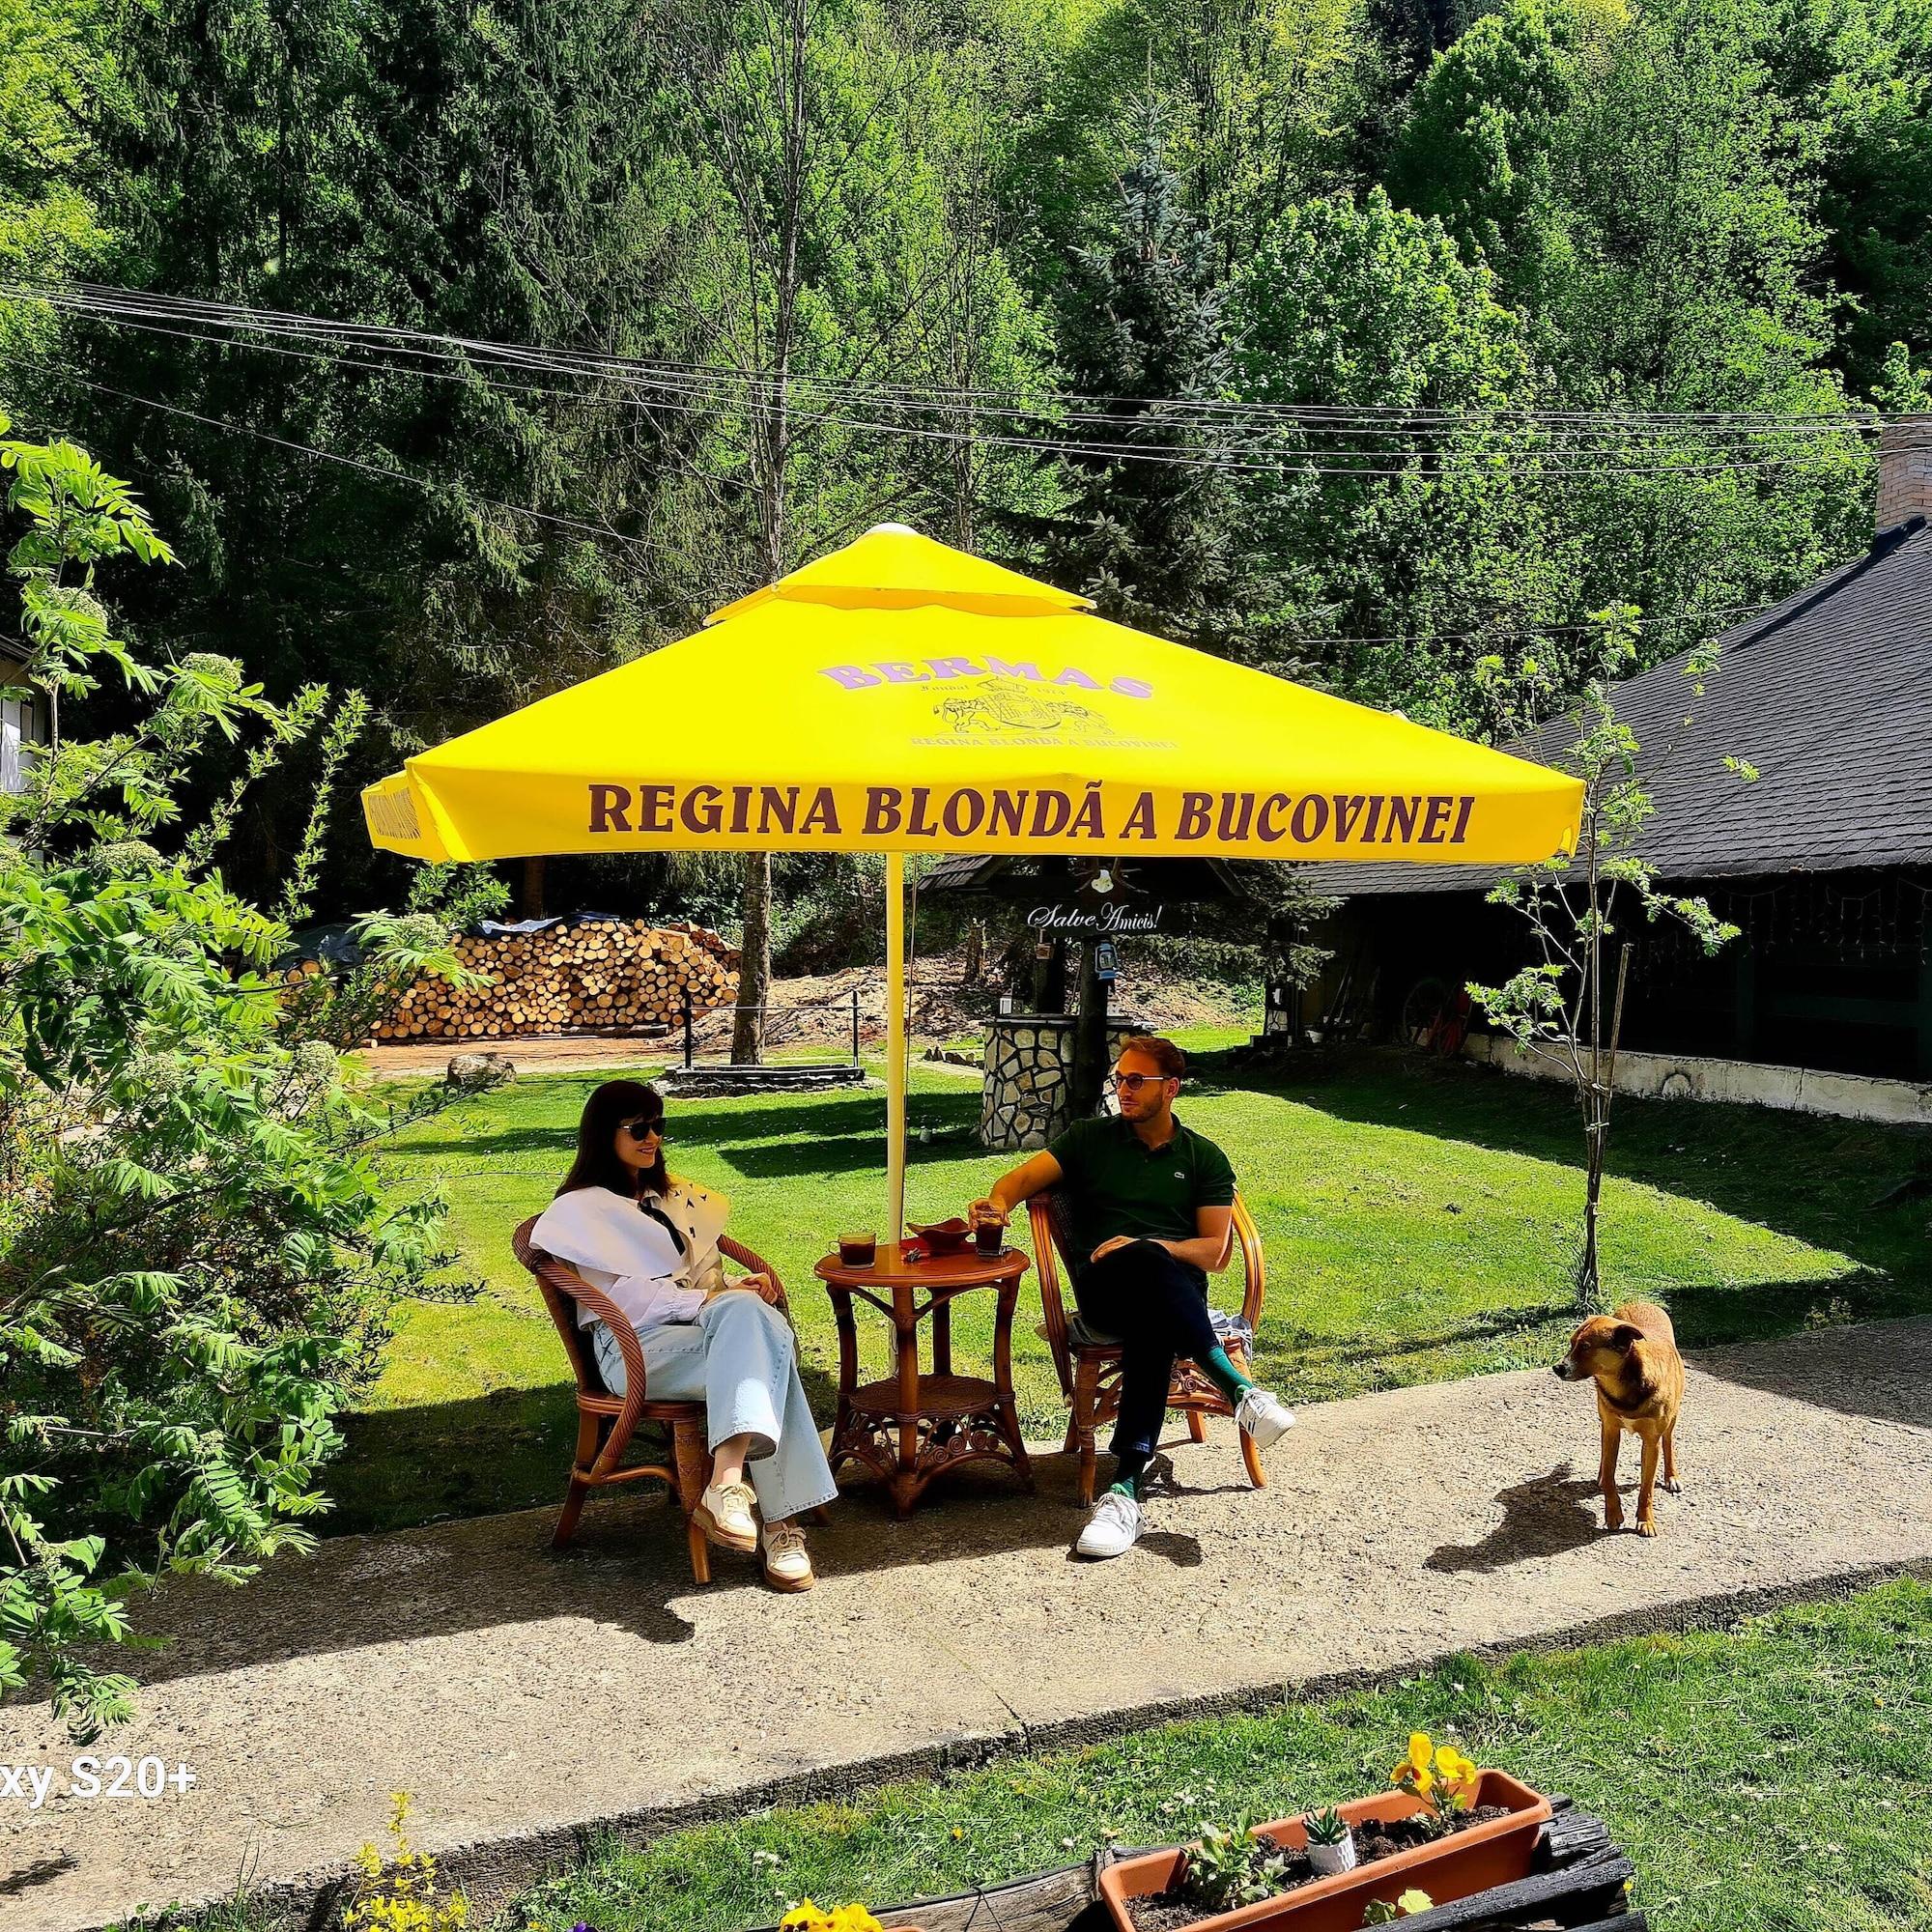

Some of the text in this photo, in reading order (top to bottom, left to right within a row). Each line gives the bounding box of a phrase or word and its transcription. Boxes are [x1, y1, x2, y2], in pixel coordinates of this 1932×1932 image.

[817, 655, 1154, 698] BERMAS
[588, 783, 841, 835] REGINA
[1119, 791, 1157, 839] A
[1174, 791, 1475, 843] BUCOVINEI
[1027, 902, 1163, 931] Salve Amicis!
